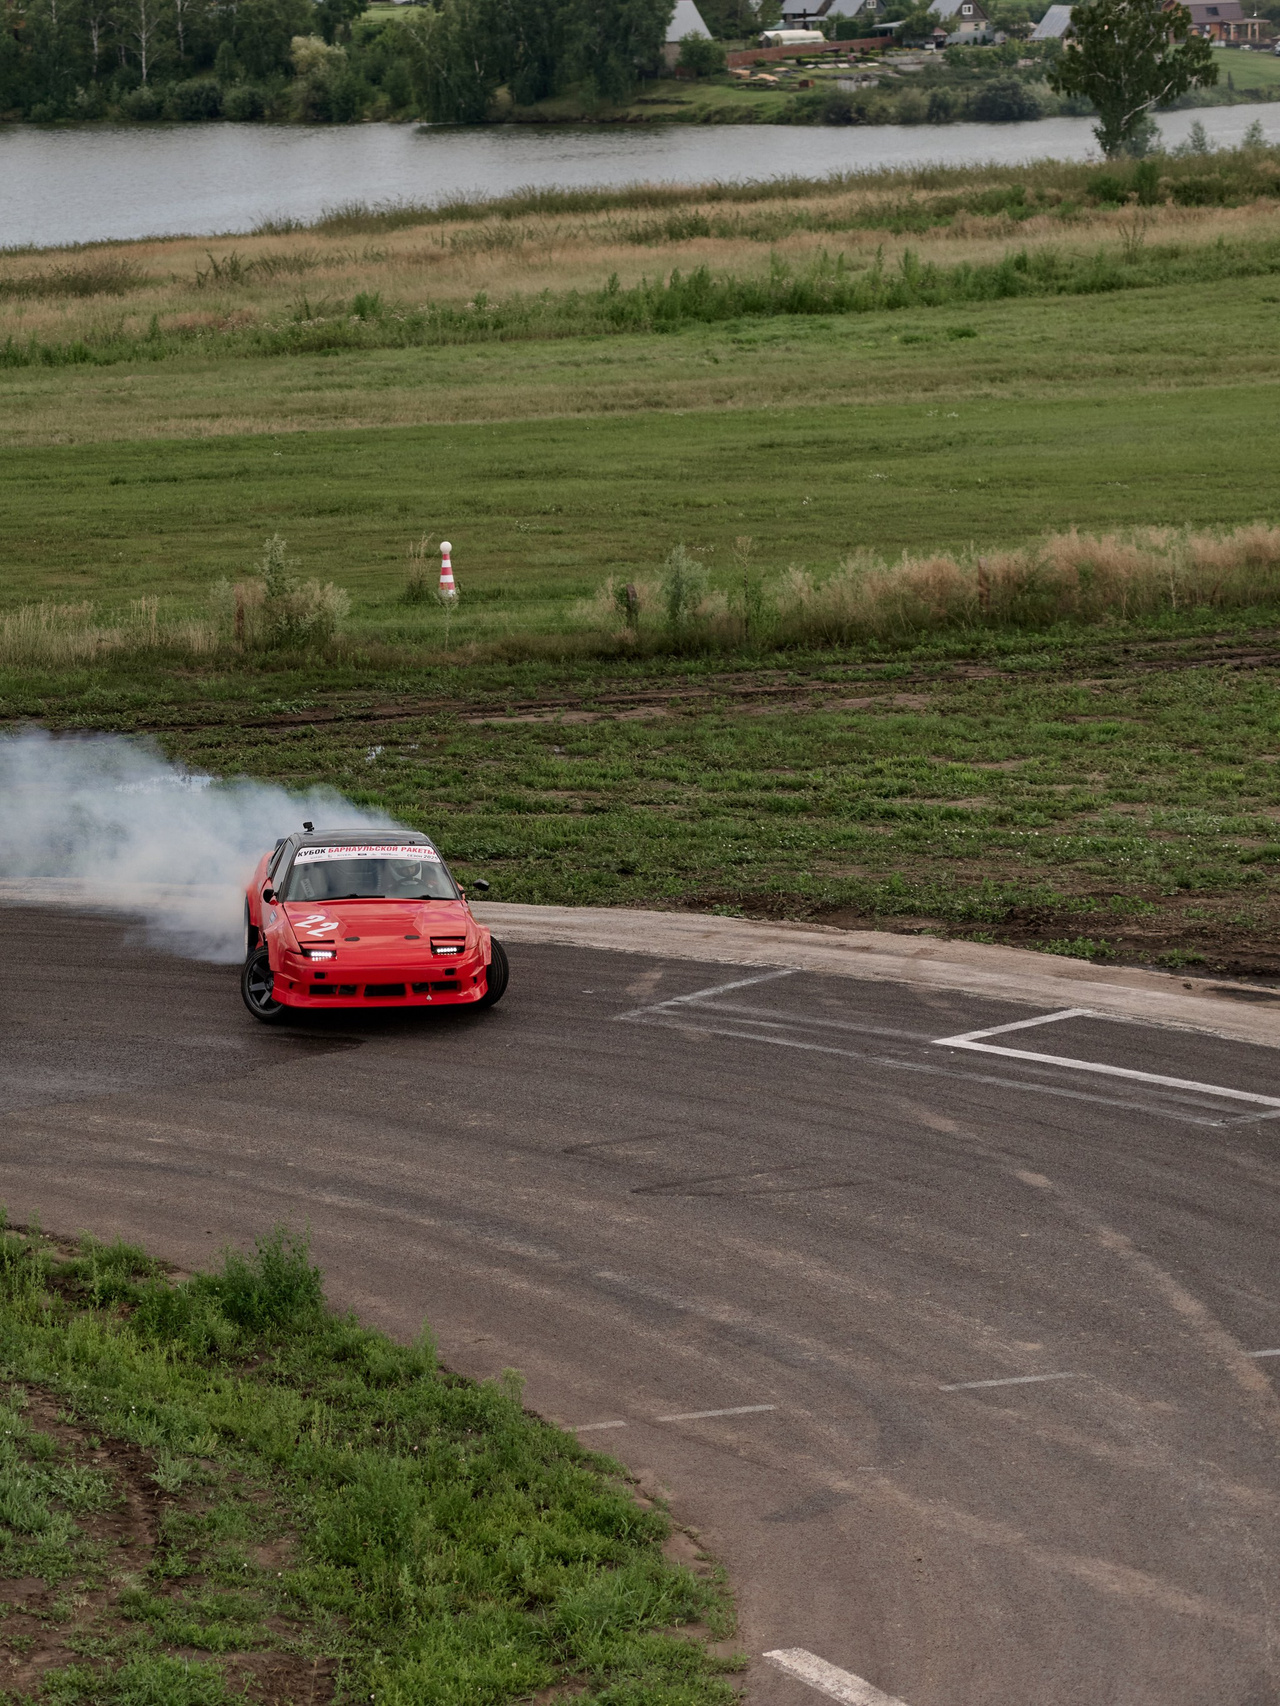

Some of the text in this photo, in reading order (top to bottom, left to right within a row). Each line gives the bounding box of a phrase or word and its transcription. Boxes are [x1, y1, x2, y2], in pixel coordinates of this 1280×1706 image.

[297, 848, 326, 857] КУБОК
[328, 845, 399, 853] БАРНАУЛЬСКОЙ
[400, 846, 437, 855] РАКЕТЫ
[294, 914, 339, 937] 22
